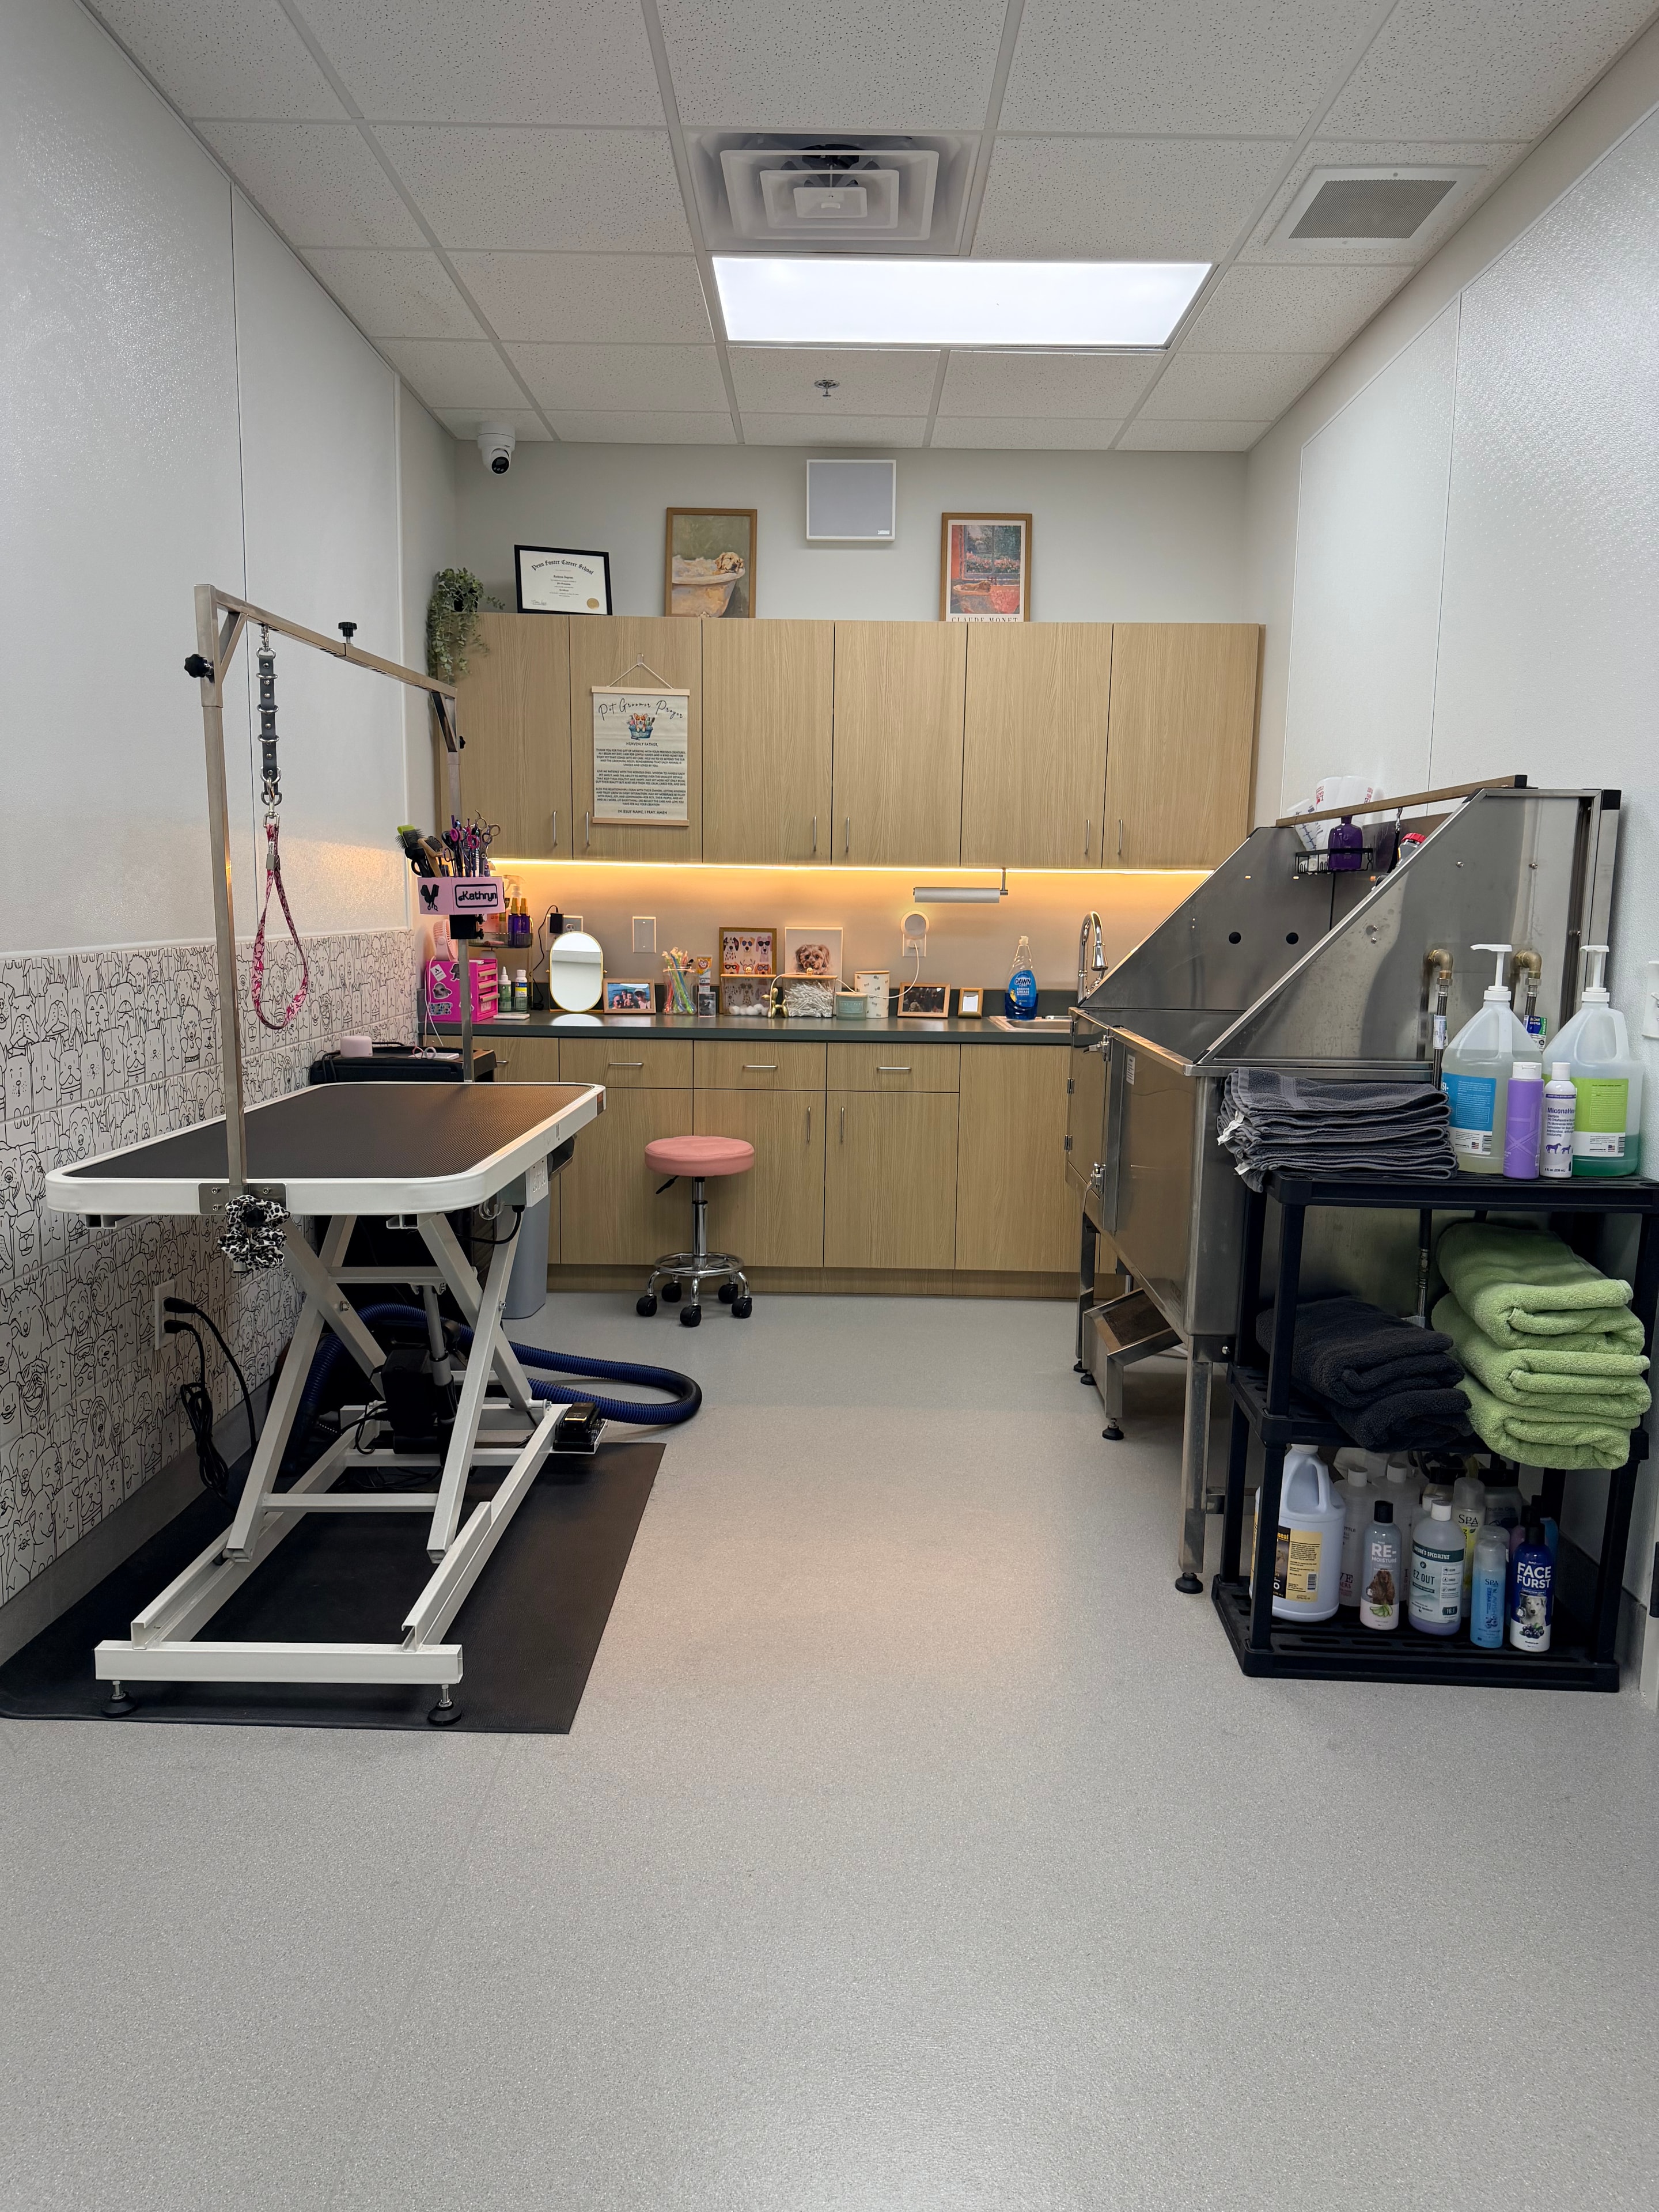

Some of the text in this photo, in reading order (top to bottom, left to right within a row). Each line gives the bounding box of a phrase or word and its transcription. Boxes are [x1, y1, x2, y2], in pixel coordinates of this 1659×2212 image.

[531, 562, 544, 571] Penn
[561, 559, 578, 567] Career
[578, 563, 594, 575] School
[599, 698, 683, 721] Pet Groomer Prayer
[458, 891, 497, 902] Kathryn
[1459, 1514, 1478, 1525] SPA
[1372, 1543, 1397, 1558] RE-
[1427, 1551, 1450, 1560] SPECIALTIES
[1413, 1569, 1435, 1585] EZ OUT
[1517, 1562, 1551, 1580] FACE
[1517, 1574, 1551, 1589] FURST
